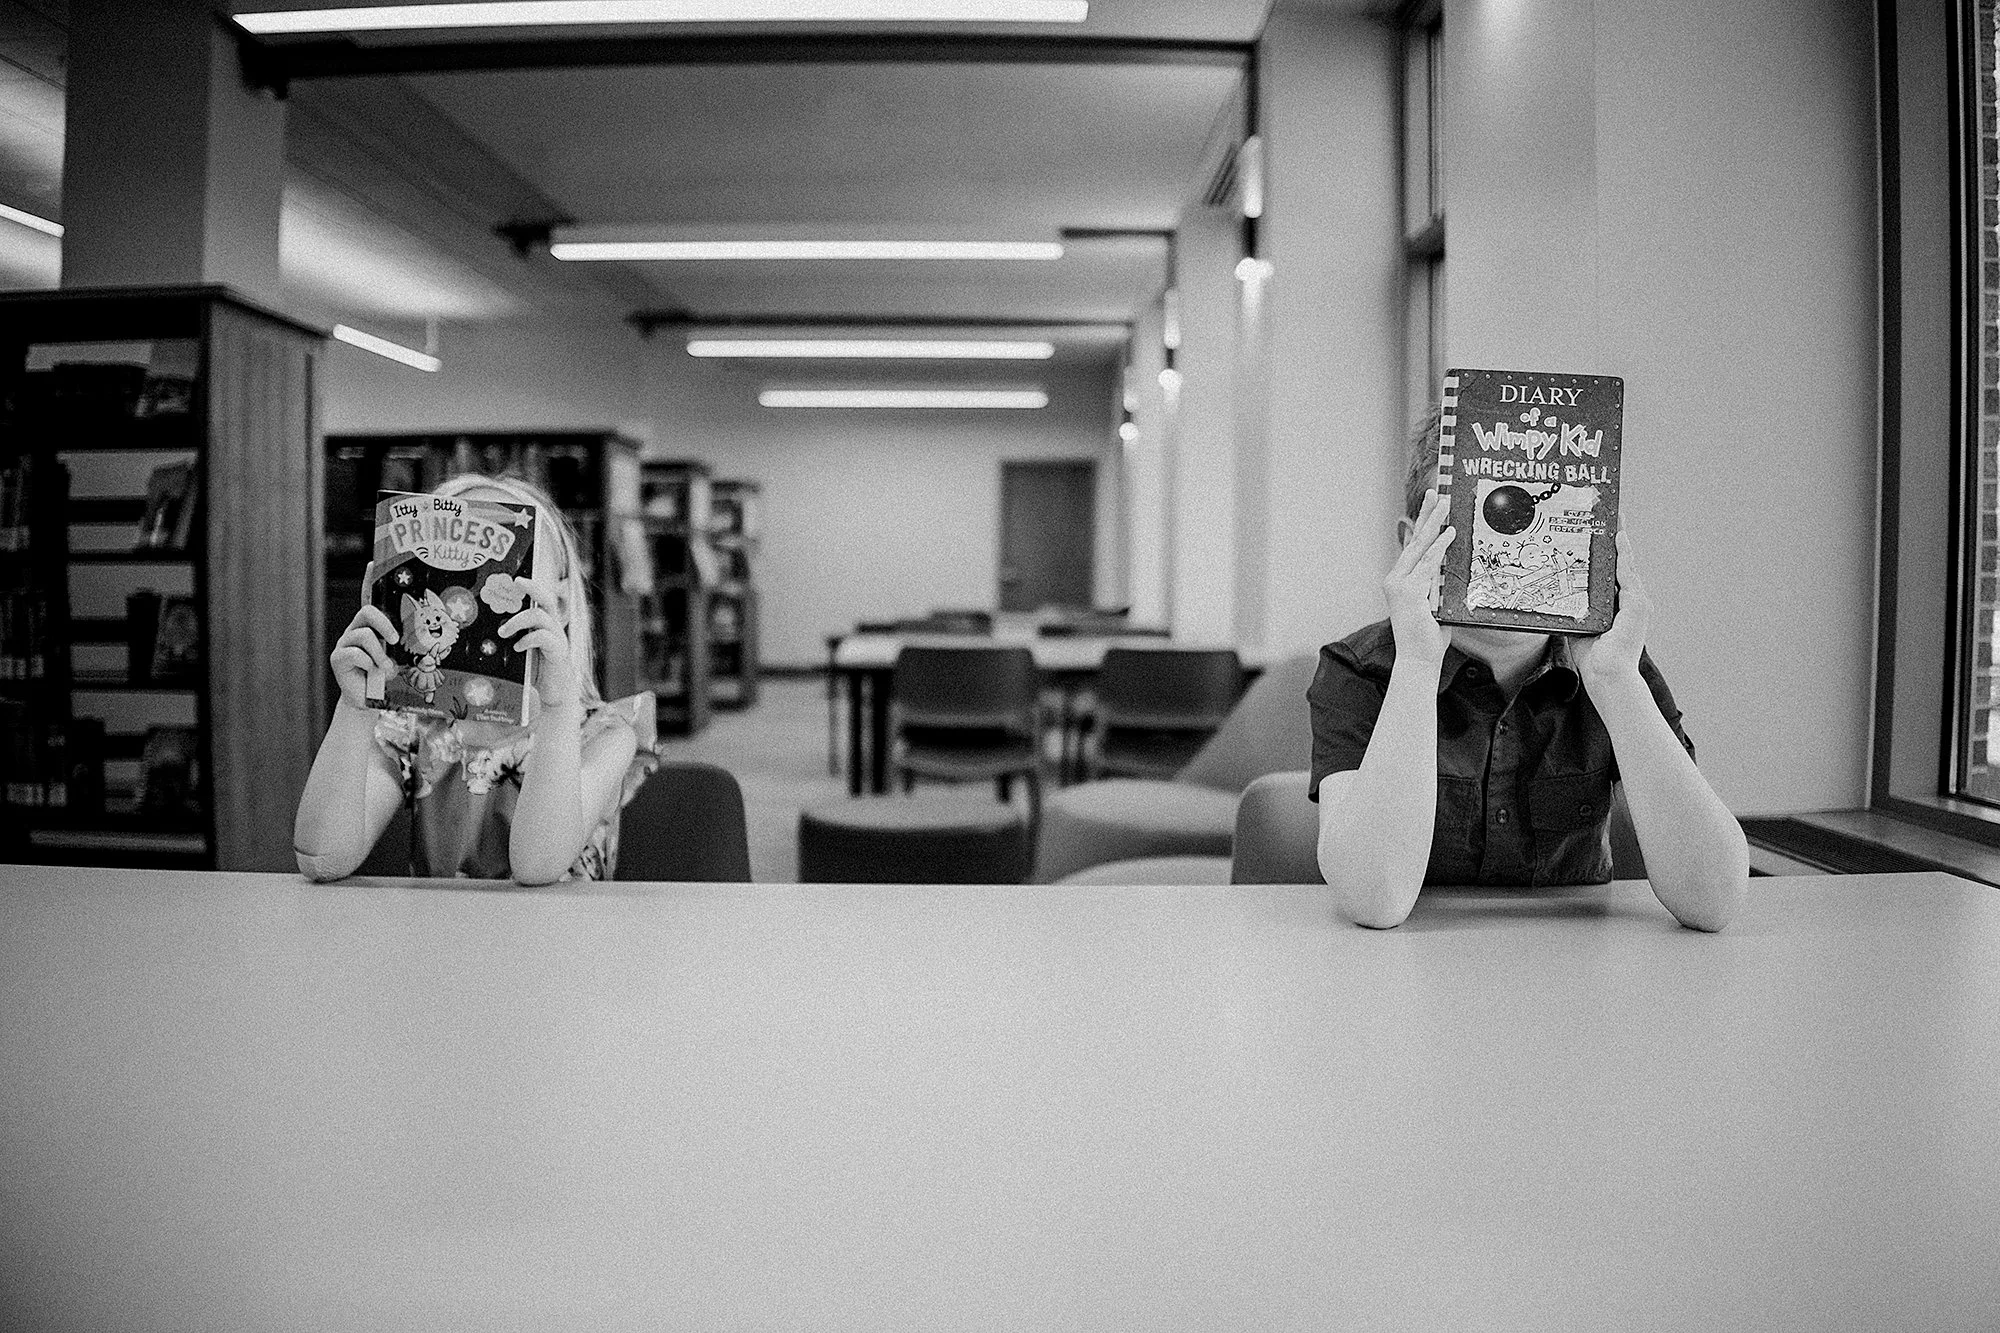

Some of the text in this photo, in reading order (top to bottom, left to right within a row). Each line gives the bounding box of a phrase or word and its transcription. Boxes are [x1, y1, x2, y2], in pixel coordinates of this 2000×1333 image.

[1500, 384, 1584, 407] DIARY
[1520, 407, 1557, 428] of a
[1471, 422, 1604, 460] Wimpy Kid
[1462, 457, 1612, 484] WRECKING BALL
[393, 498, 462, 518] Itty Bitty
[394, 517, 510, 555] PRINCESS
[433, 544, 469, 568] Kitty
